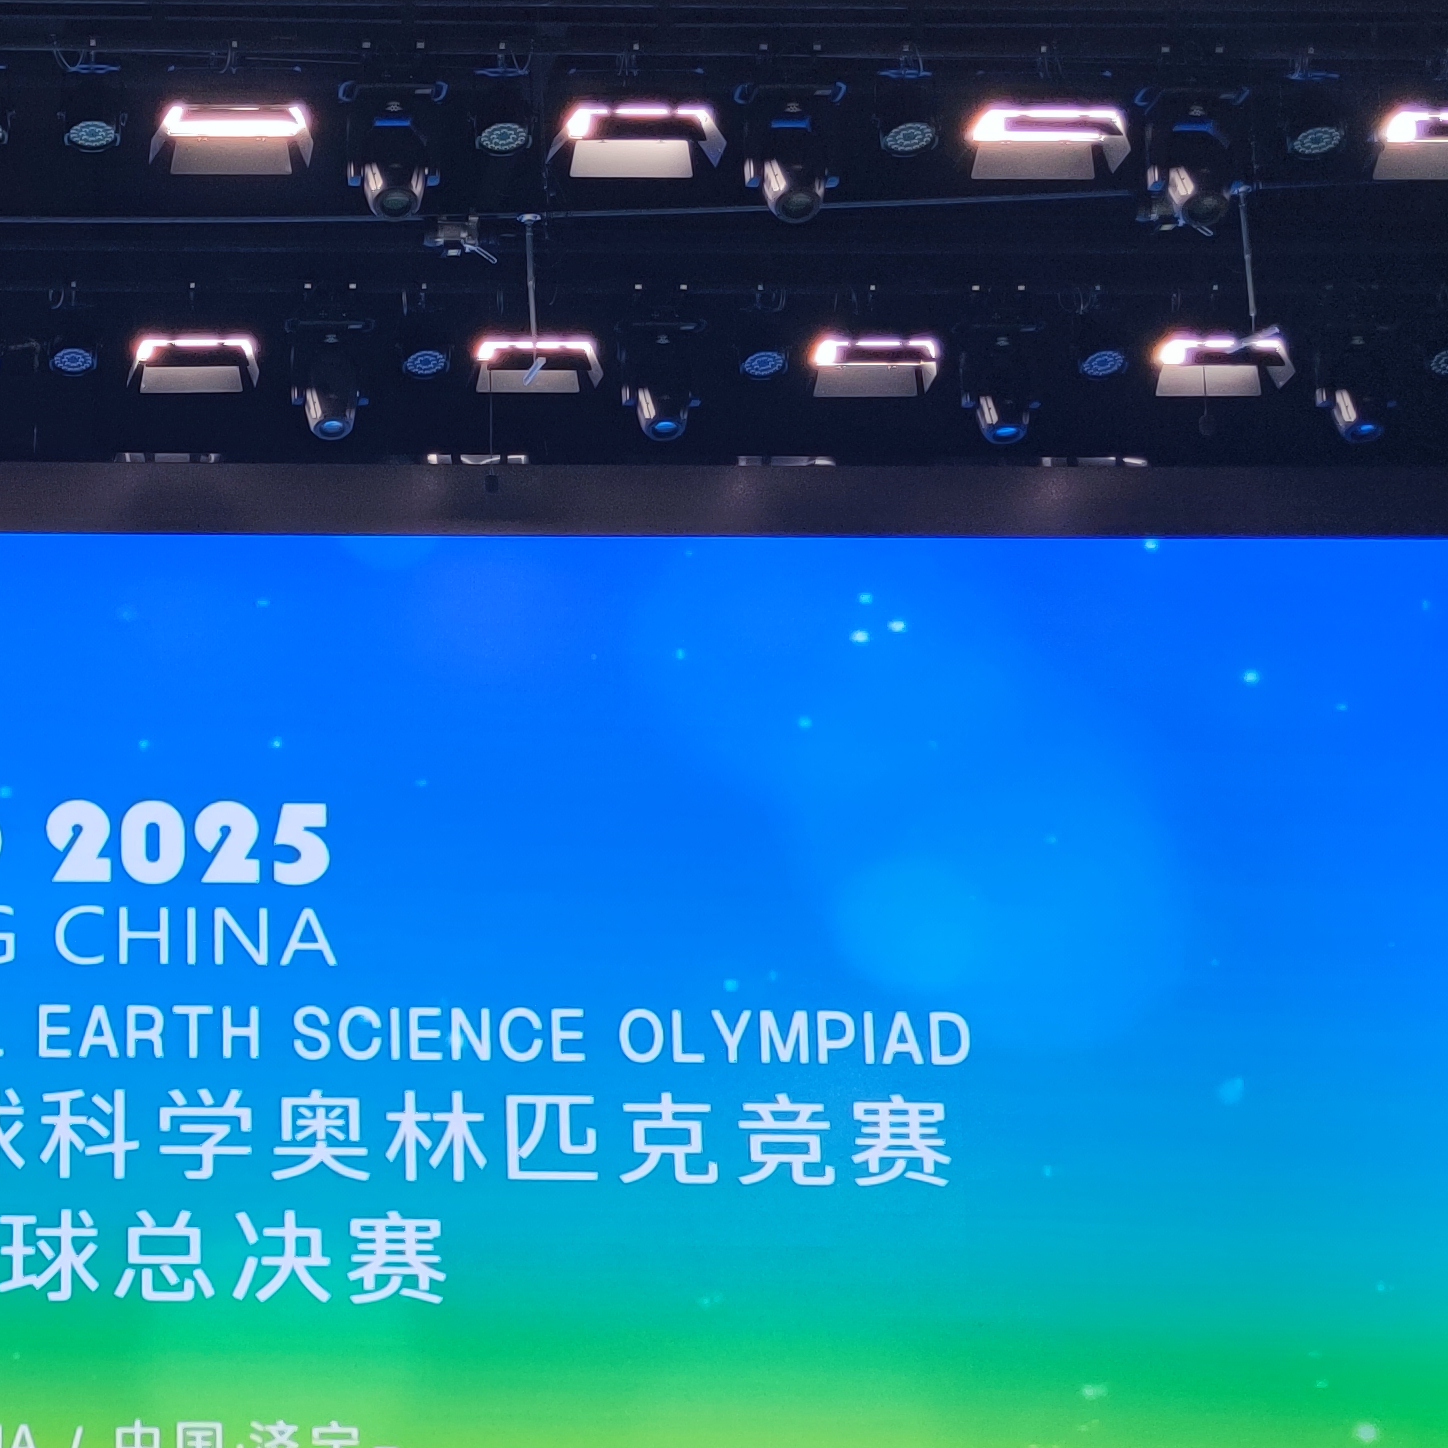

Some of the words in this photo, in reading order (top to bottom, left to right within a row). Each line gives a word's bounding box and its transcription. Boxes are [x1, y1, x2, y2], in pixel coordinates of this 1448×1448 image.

[45, 799, 331, 886] 2025
[54, 905, 338, 966] CHINA
[37, 1004, 260, 1060] EARTH
[293, 1005, 587, 1063] SCIENCE
[618, 1008, 972, 1066] OLYMPIAD
